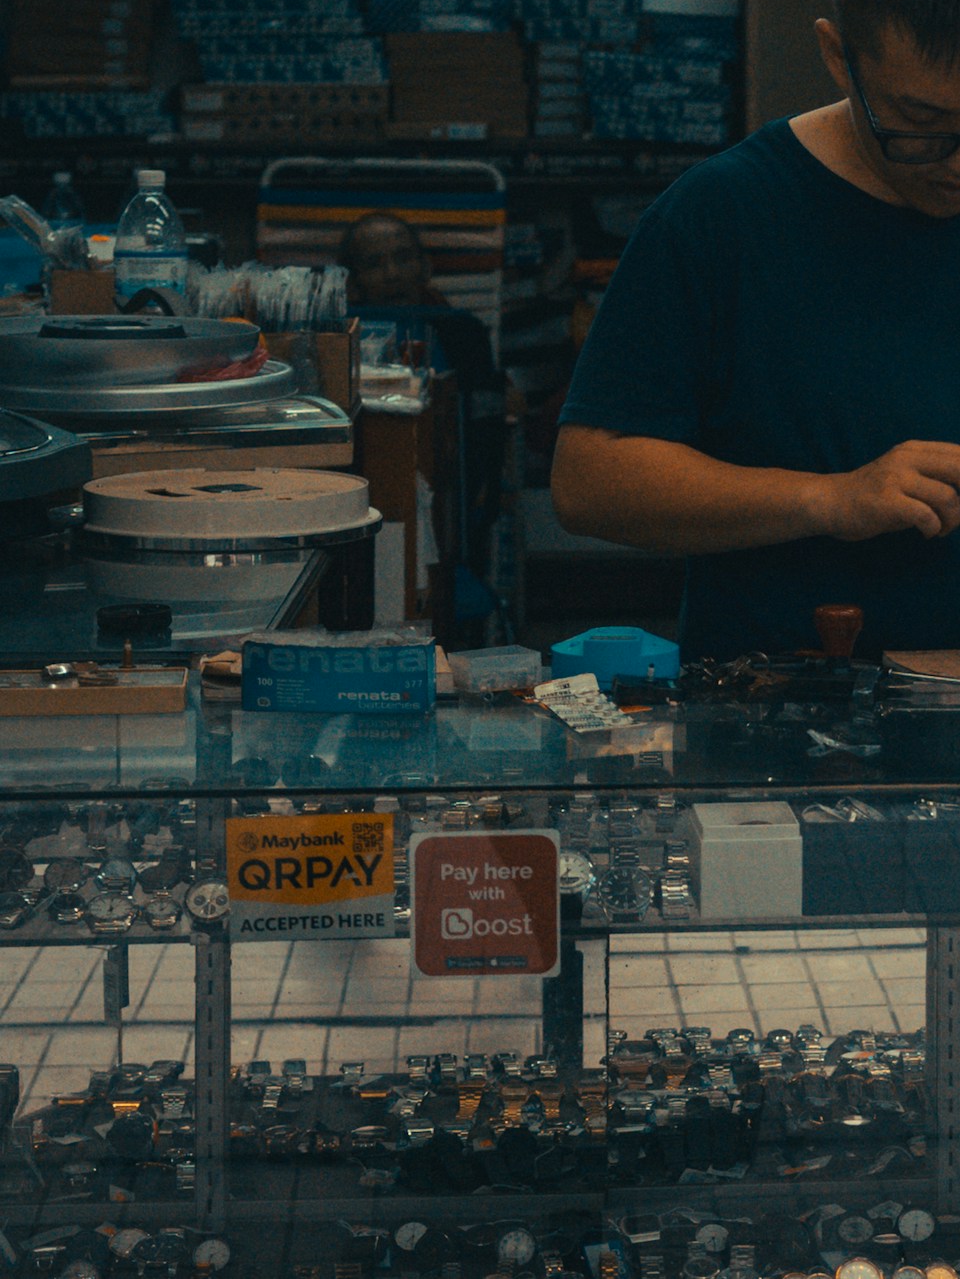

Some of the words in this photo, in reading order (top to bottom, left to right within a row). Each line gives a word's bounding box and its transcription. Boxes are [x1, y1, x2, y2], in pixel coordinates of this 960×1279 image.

[243, 645, 426, 673] renata
[257, 677, 273, 686] 100
[337, 691, 400, 701] renata
[358, 700, 421, 709] batteries
[261, 831, 345, 850] Maybank
[238, 854, 383, 891] QRPAY
[440, 864, 478, 885] Pay
[484, 862, 534, 880] here
[468, 887, 506, 900] with
[240, 915, 334, 933] ACCEPTED
[338, 913, 385, 928] HERE
